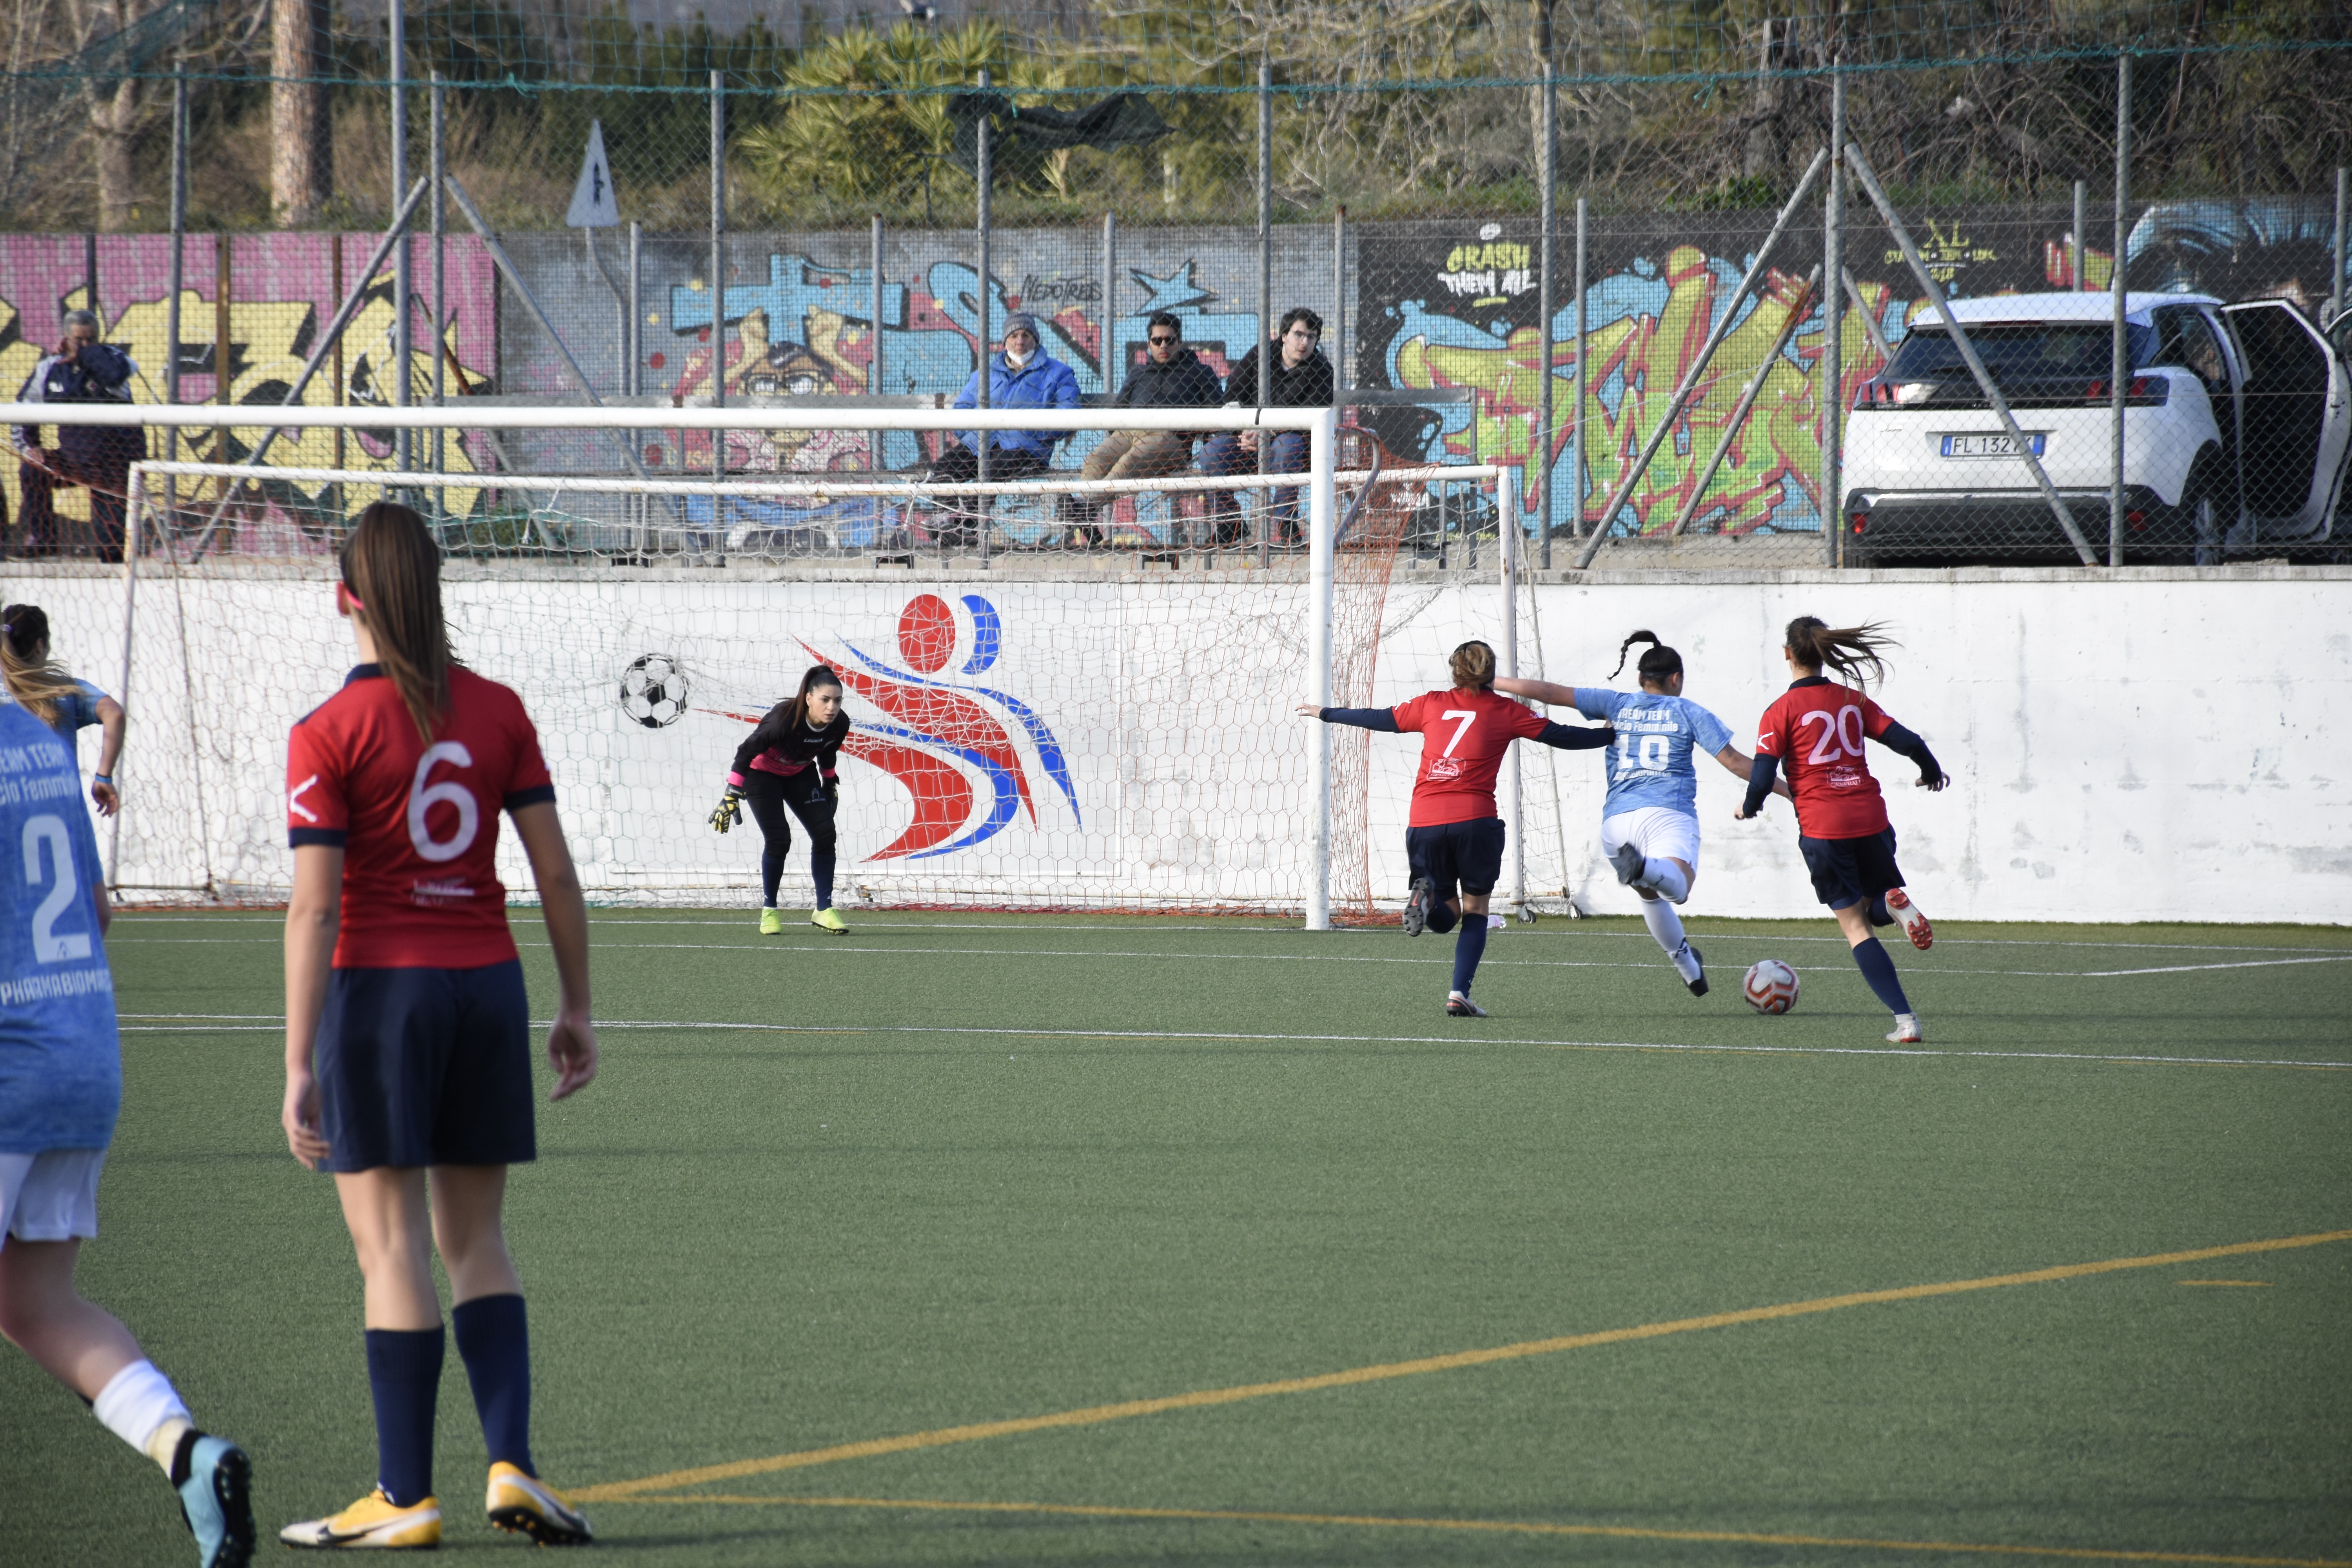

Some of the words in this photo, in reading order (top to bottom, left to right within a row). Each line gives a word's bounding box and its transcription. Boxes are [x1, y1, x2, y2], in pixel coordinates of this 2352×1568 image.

[1954, 438, 1972, 453] FL
[1441, 710, 1477, 758] 7
[1633, 721, 1679, 731] Femminile
[1648, 710, 1670, 720] TEAM
[1801, 705, 1864, 765] 20
[1613, 734, 1670, 771] 10
[407, 740, 479, 862] 6
[22, 814, 92, 964] 2
